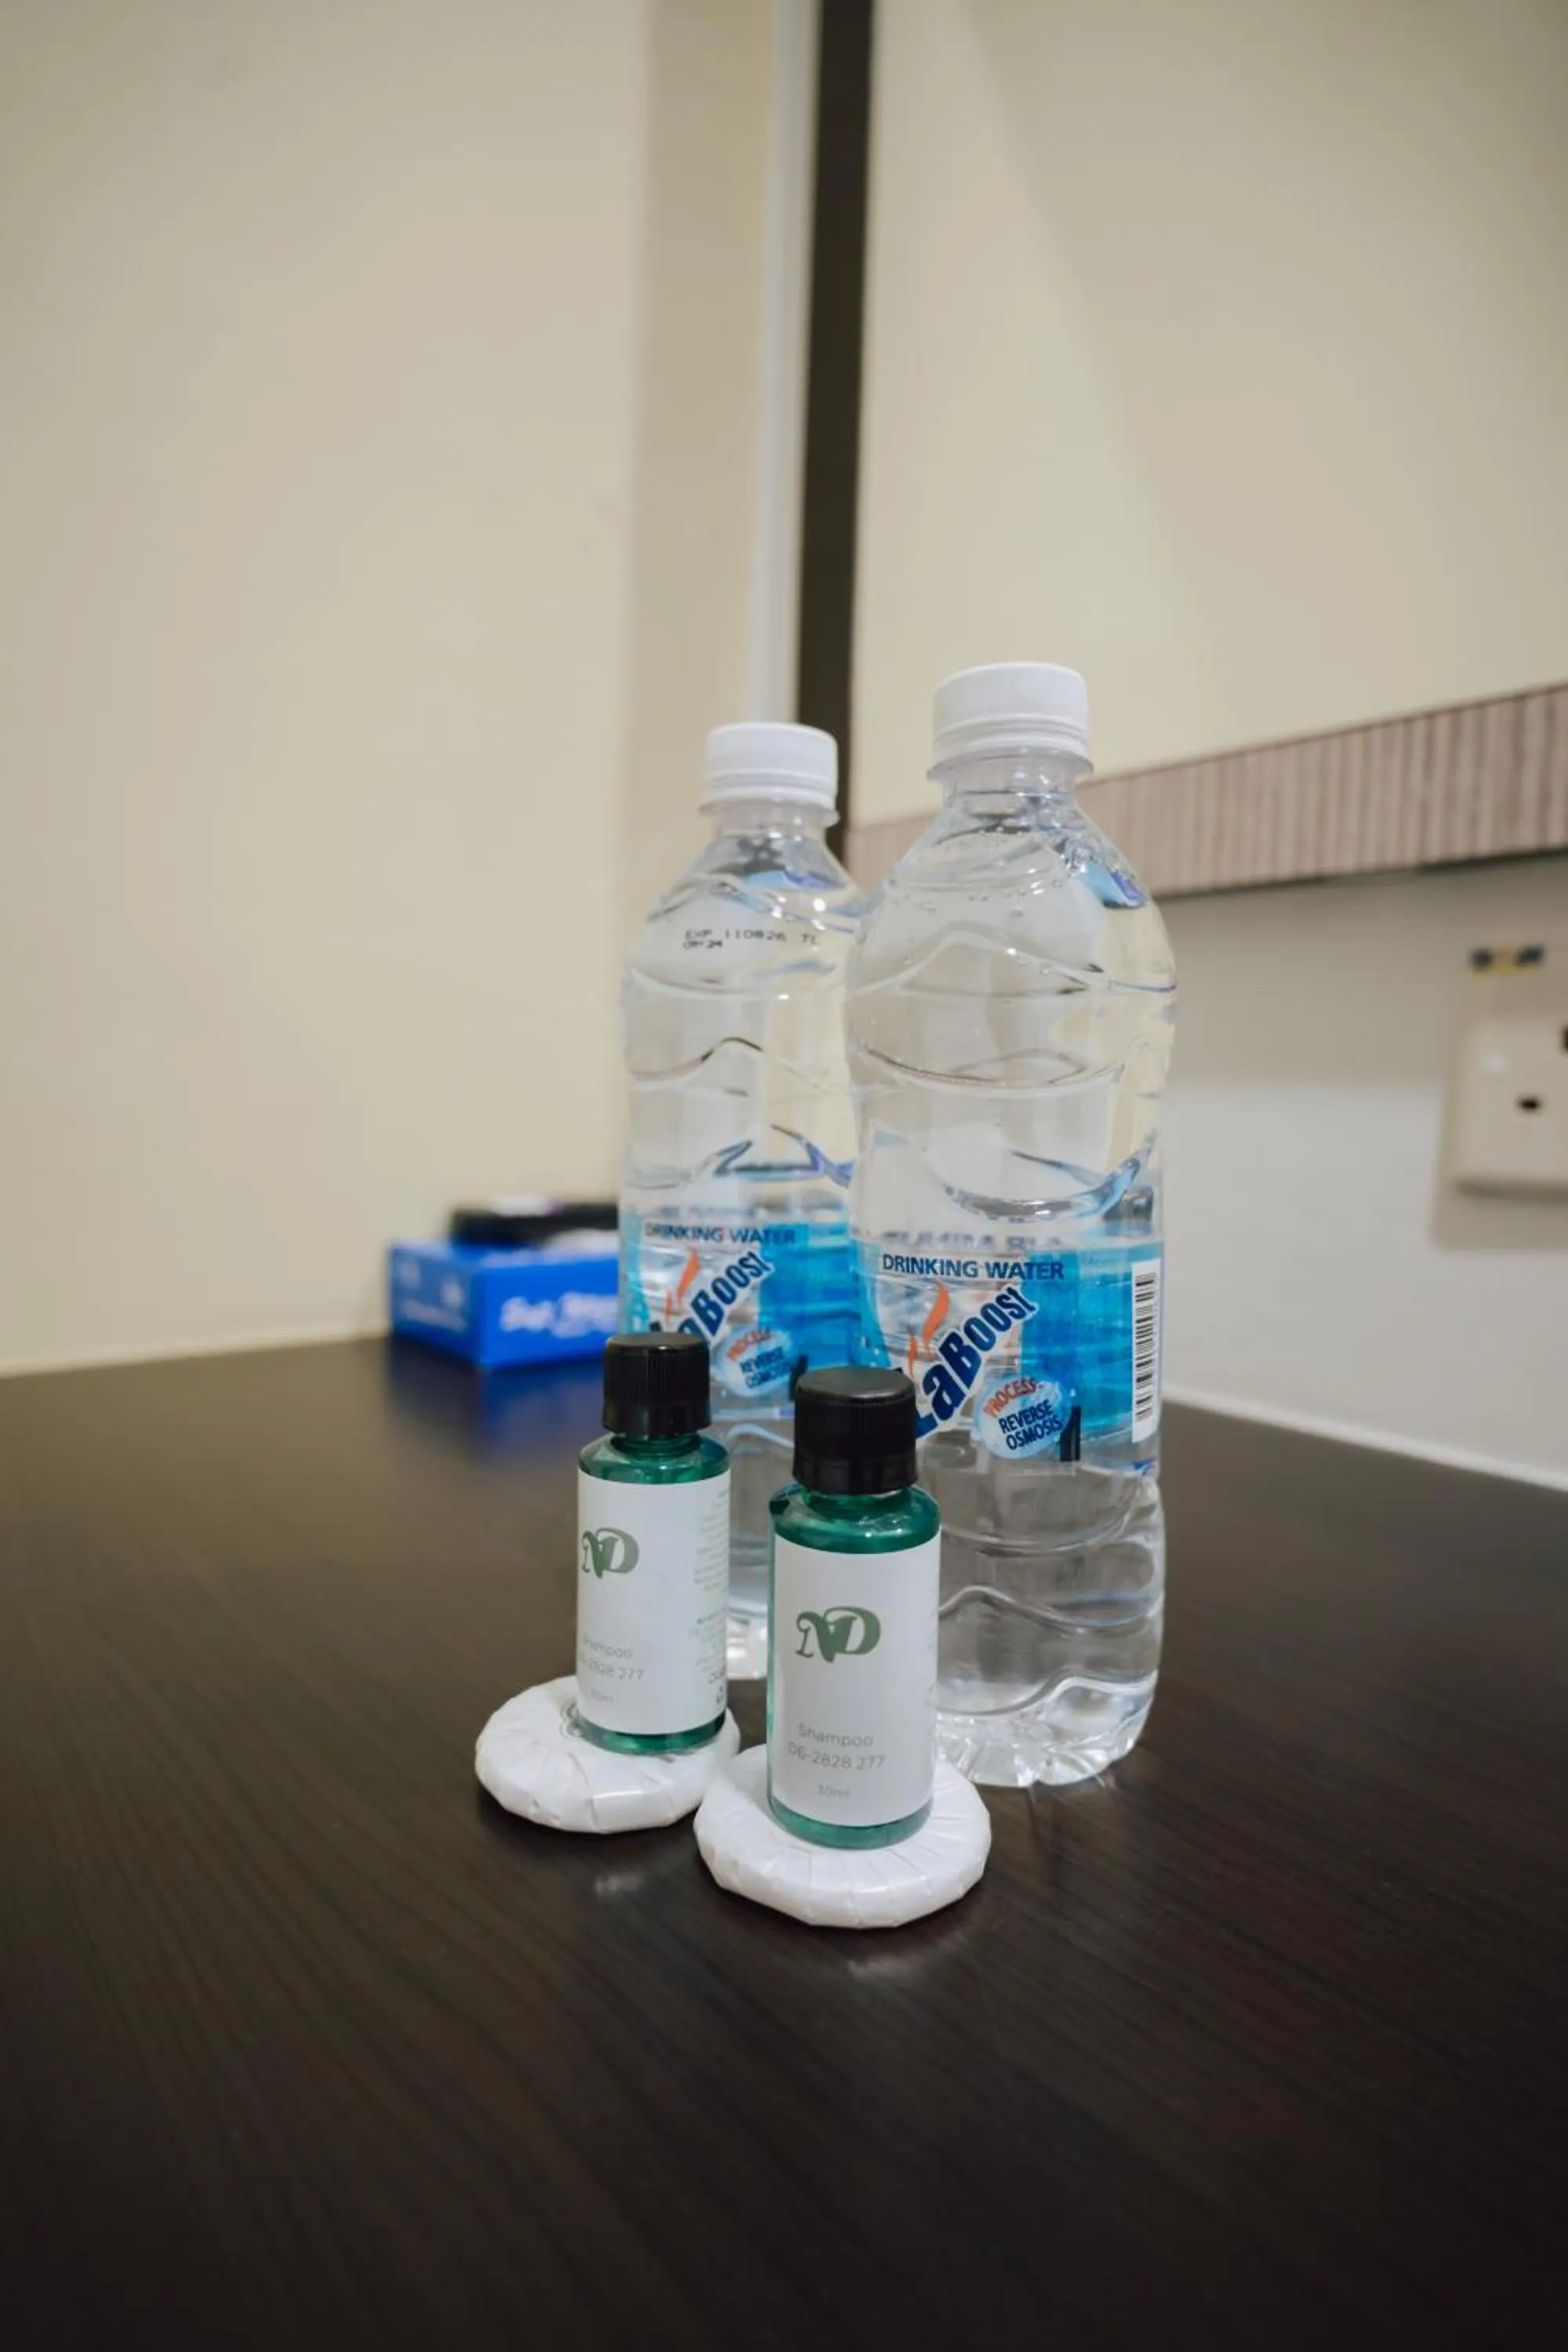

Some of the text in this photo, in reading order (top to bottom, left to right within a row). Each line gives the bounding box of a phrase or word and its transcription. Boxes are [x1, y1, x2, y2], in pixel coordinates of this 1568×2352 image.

[645, 1223, 797, 1245] DRINKING WATER
[883, 1254, 1065, 1281] DRINKING WATER
[983, 1377, 1037, 1418] PROCESS
[998, 1399, 1054, 1435] REVERSE
[1006, 1415, 1064, 1450] OSMOSIS
[798, 1722, 873, 1748] Shampoo
[855, 1754, 886, 1771] 277
